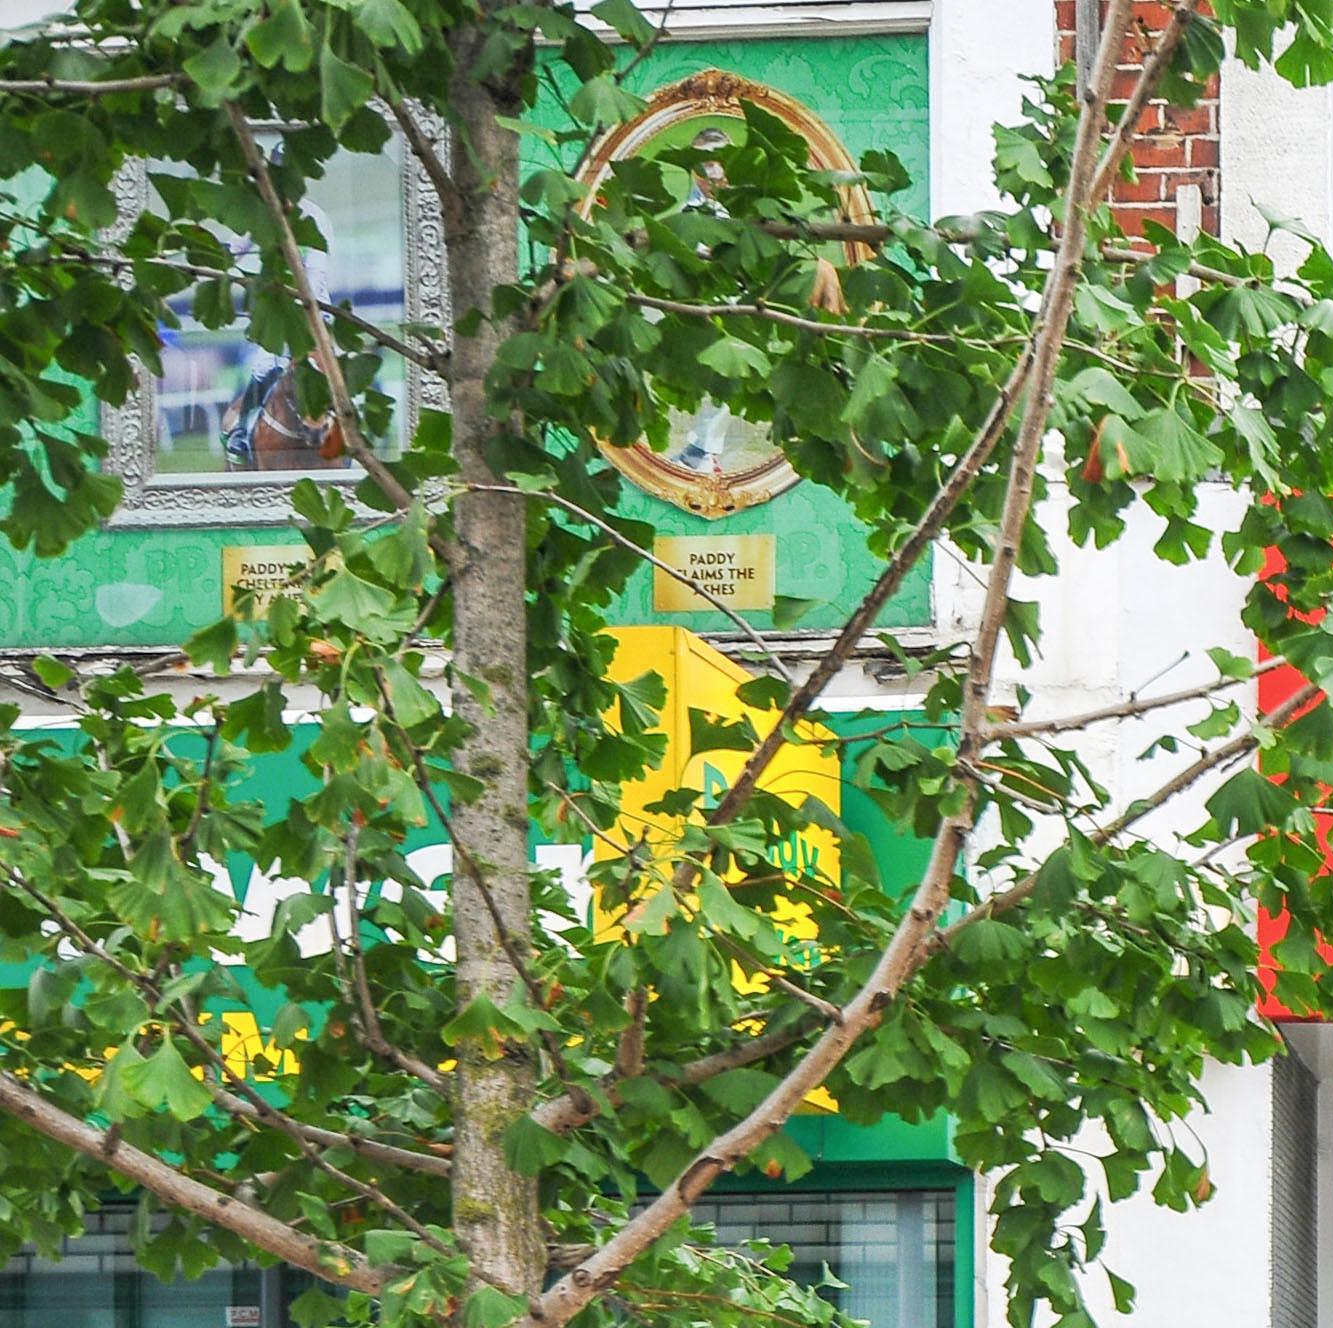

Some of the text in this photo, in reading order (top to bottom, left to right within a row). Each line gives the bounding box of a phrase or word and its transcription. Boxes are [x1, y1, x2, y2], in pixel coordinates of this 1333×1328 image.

[690, 553, 735, 565] PADDY
[241, 563, 285, 575] PADDY
[728, 567, 755, 580] THE
